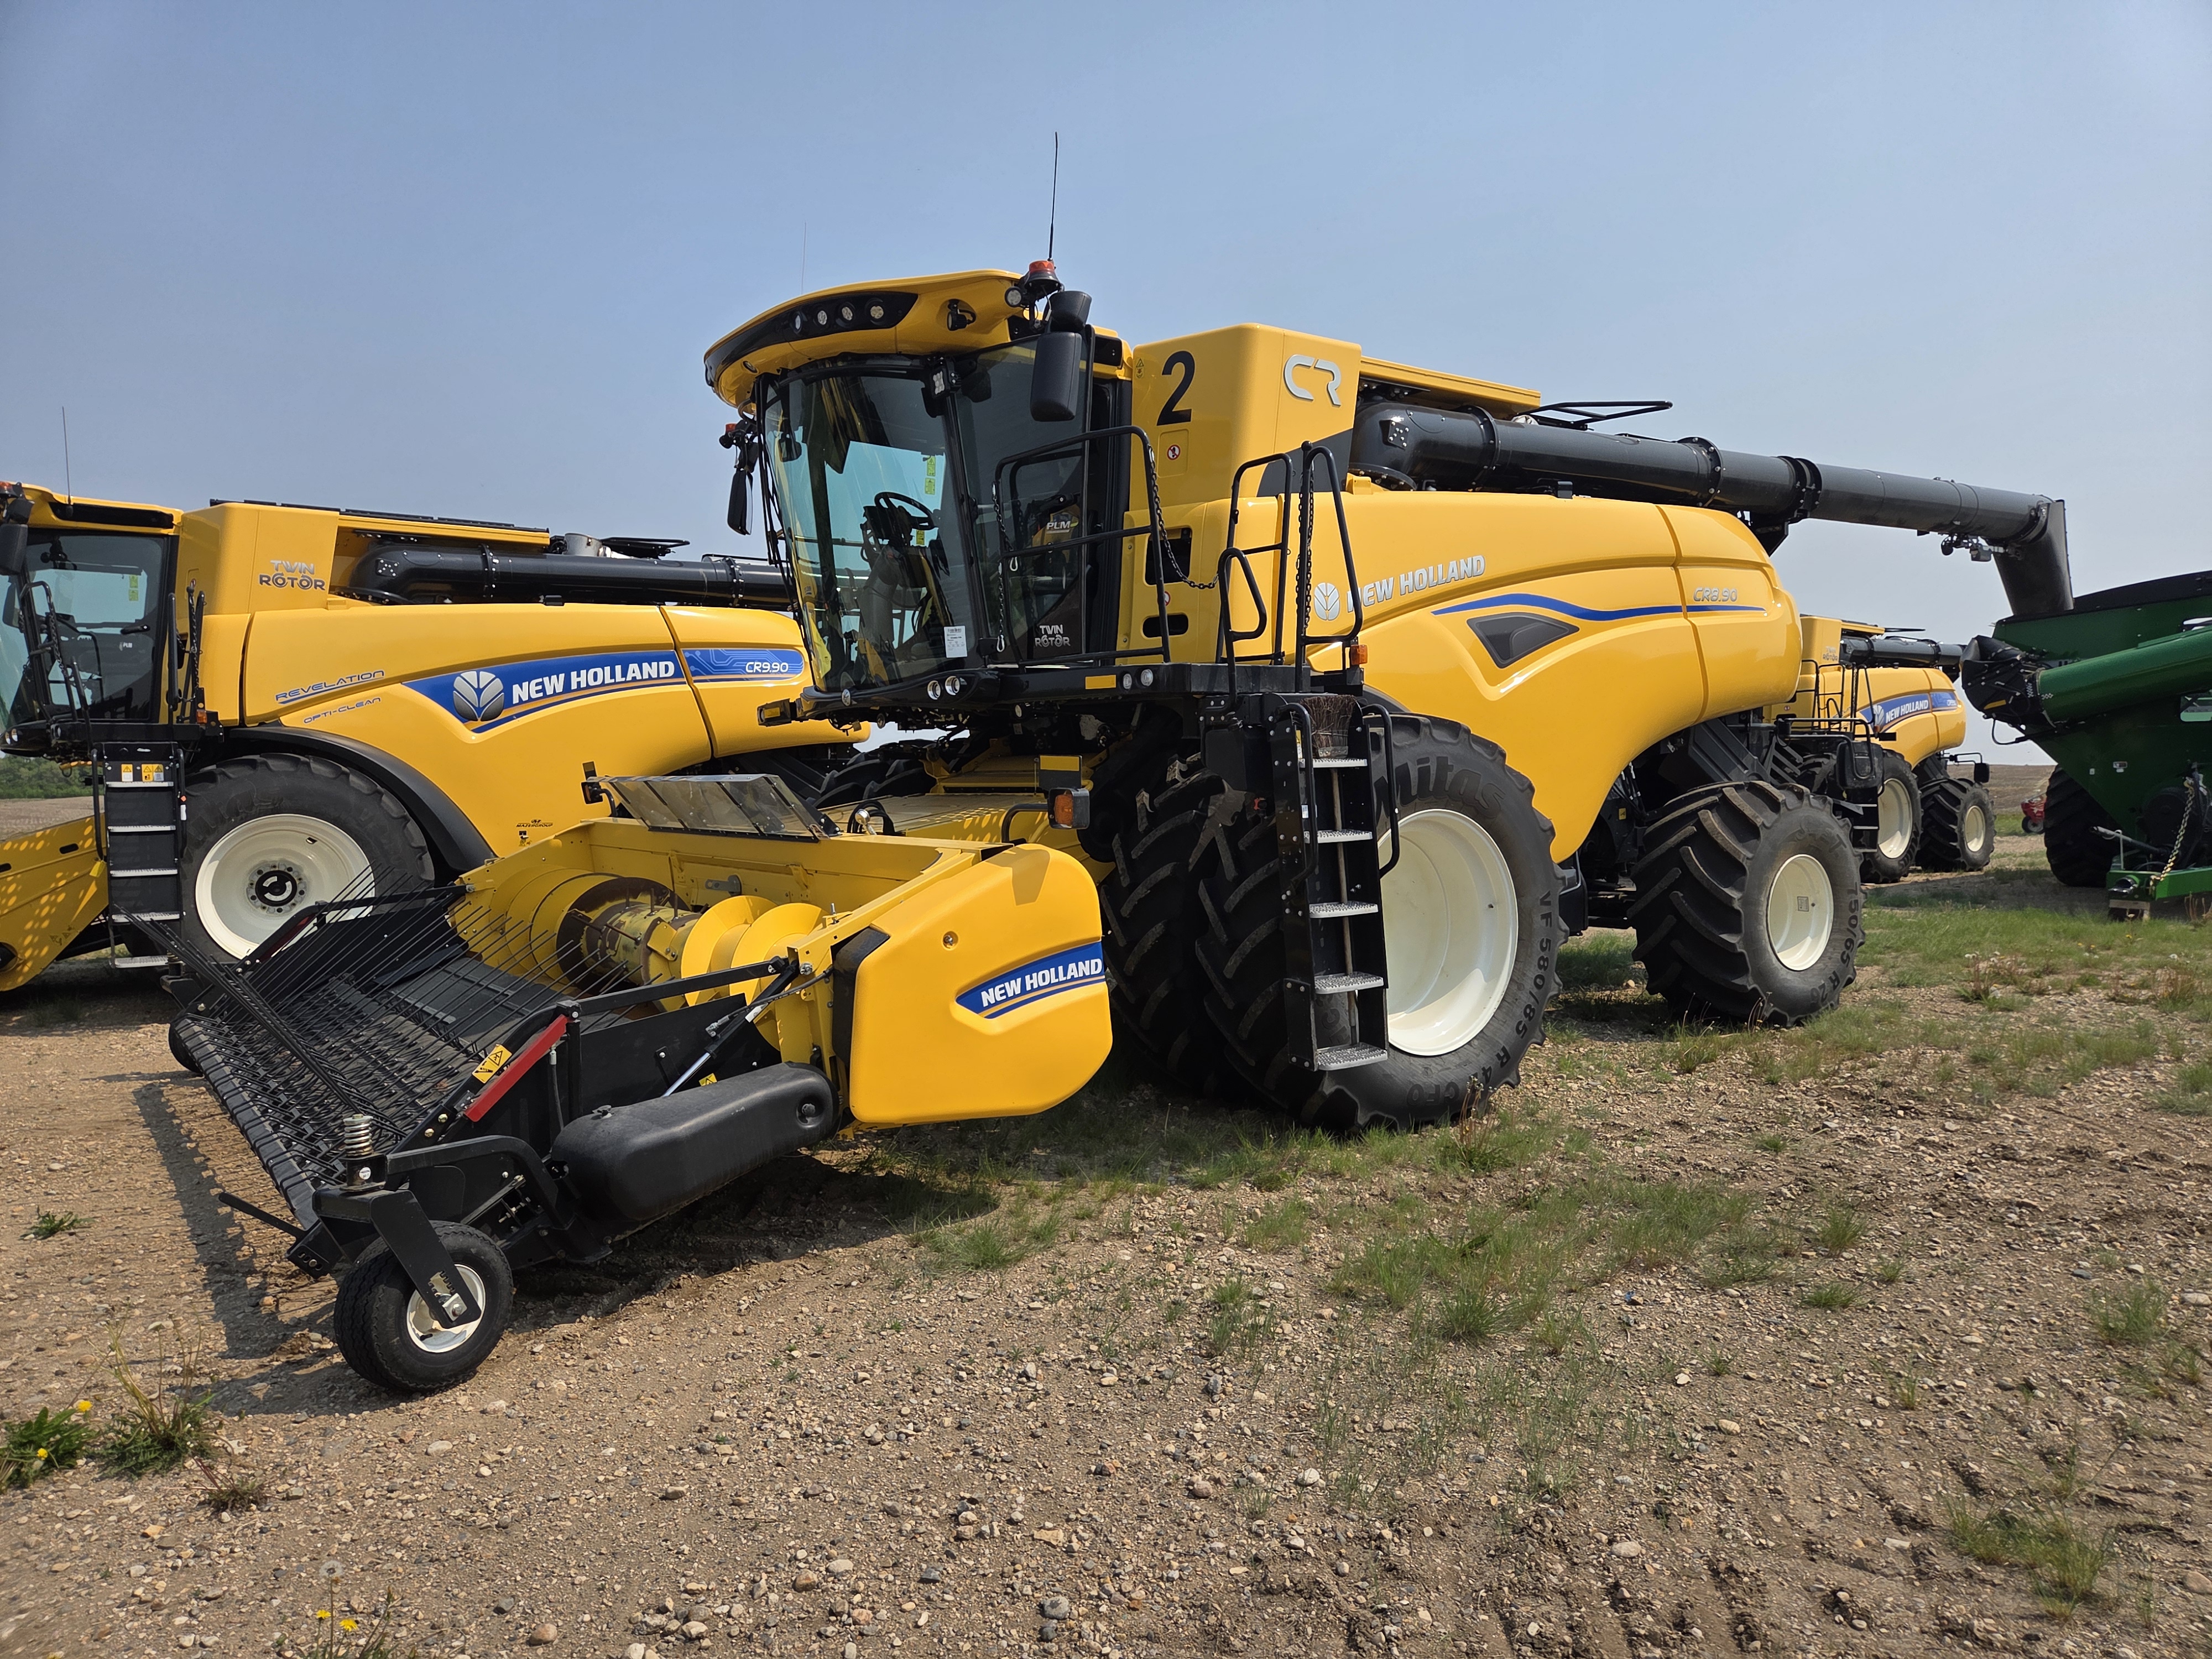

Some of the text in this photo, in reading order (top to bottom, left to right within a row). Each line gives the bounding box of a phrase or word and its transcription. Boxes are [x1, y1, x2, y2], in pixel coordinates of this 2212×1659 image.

[1156, 350, 1196, 426] 2
[1283, 354, 1342, 408] CR
[1046, 520, 1071, 530] PLM
[270, 560, 315, 575] TWIN
[1400, 555, 1485, 596] HOLLAND
[259, 572, 326, 591] ROTOR
[1693, 587, 1738, 602] CR8.90
[1035, 635, 1071, 647] ROTOR
[1040, 624, 1063, 635] TWIN
[745, 661, 789, 673] CR9.90
[275, 670, 384, 701] REVELATION
[513, 661, 675, 705] NEW HOLLAND
[304, 697, 381, 724] OPTI-CLEAN
[1886, 700, 1929, 724] NEW HOLLAND
[1539, 890, 1552, 928] VF
[1840, 881, 1859, 968] 750/65
[981, 958, 1103, 1007] NEW HOLLAND
[1515, 937, 1551, 1040] 580/85
[1828, 971, 1840, 991] R
[1495, 1045, 1511, 1068] R
